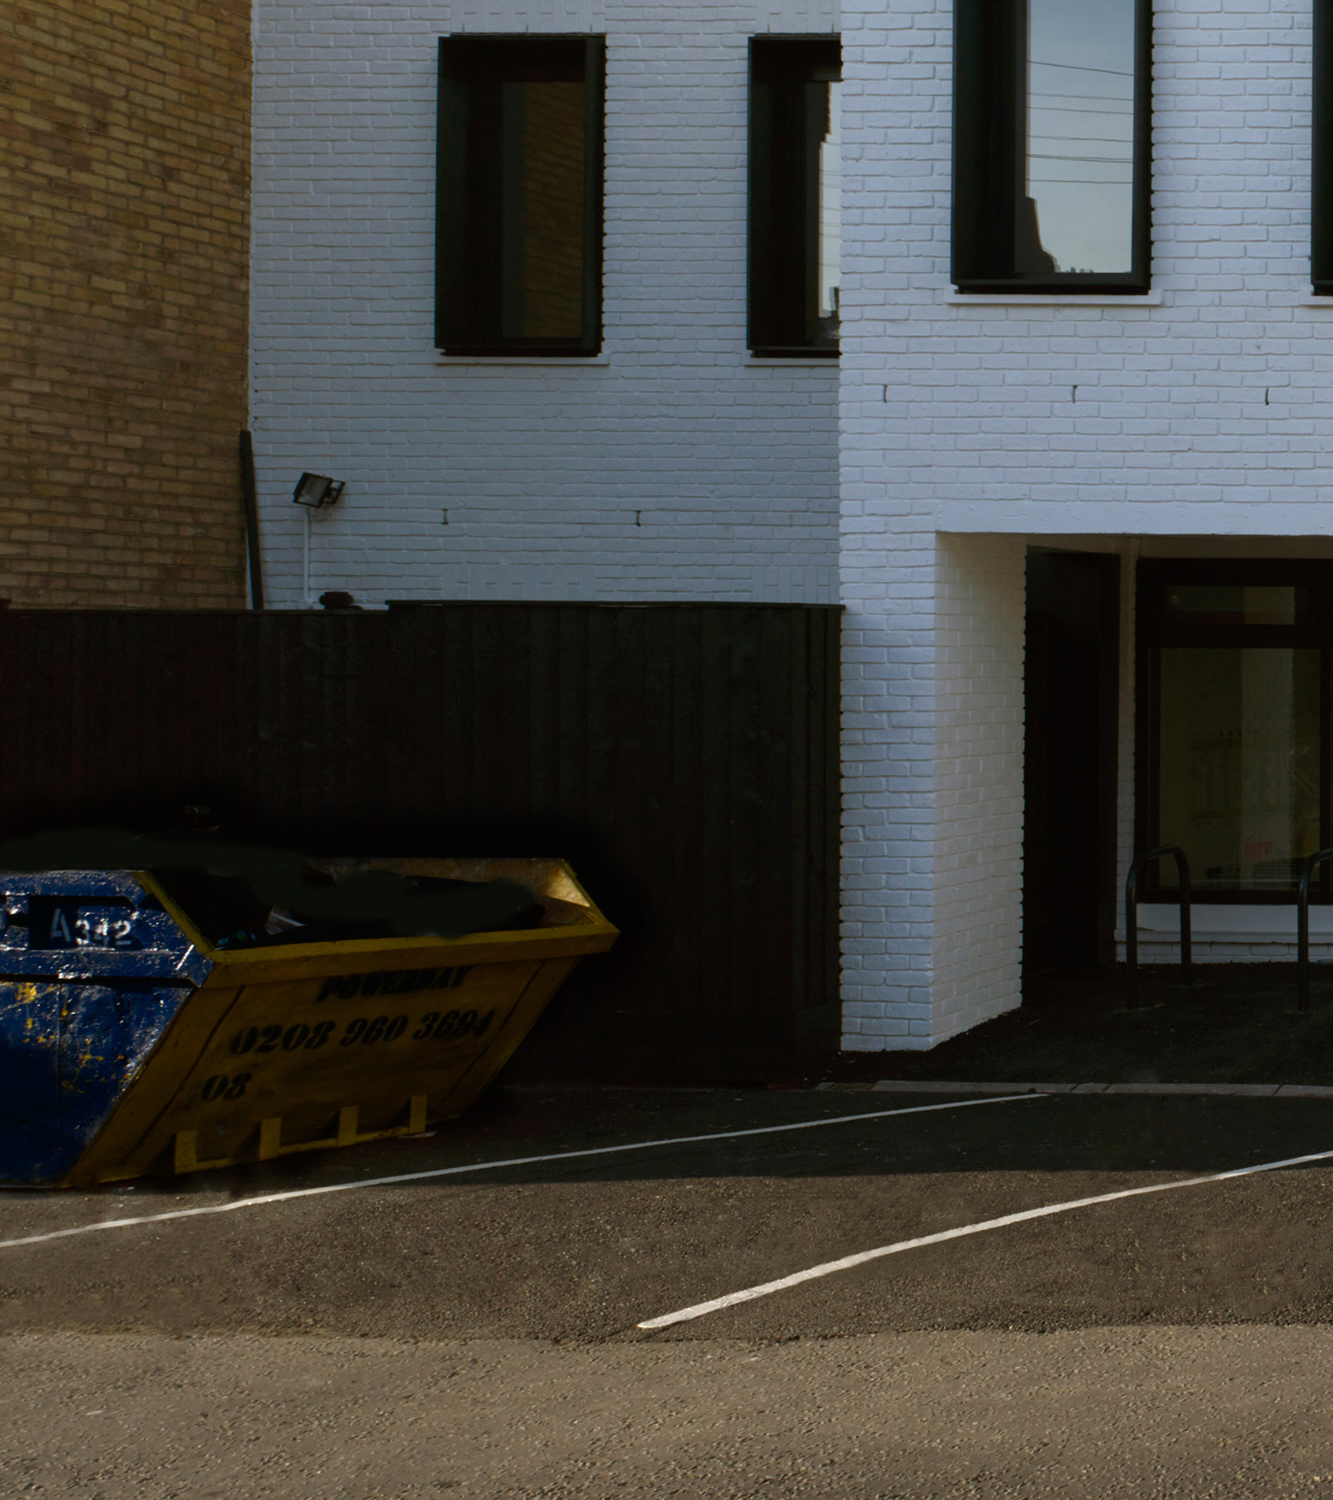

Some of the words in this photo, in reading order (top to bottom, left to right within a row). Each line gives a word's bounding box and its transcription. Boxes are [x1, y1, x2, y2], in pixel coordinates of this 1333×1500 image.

[231, 1021, 336, 1055] 0208
[340, 1015, 408, 1046] 960
[412, 1008, 496, 1041] 3694
[201, 1072, 253, 1101] 08
